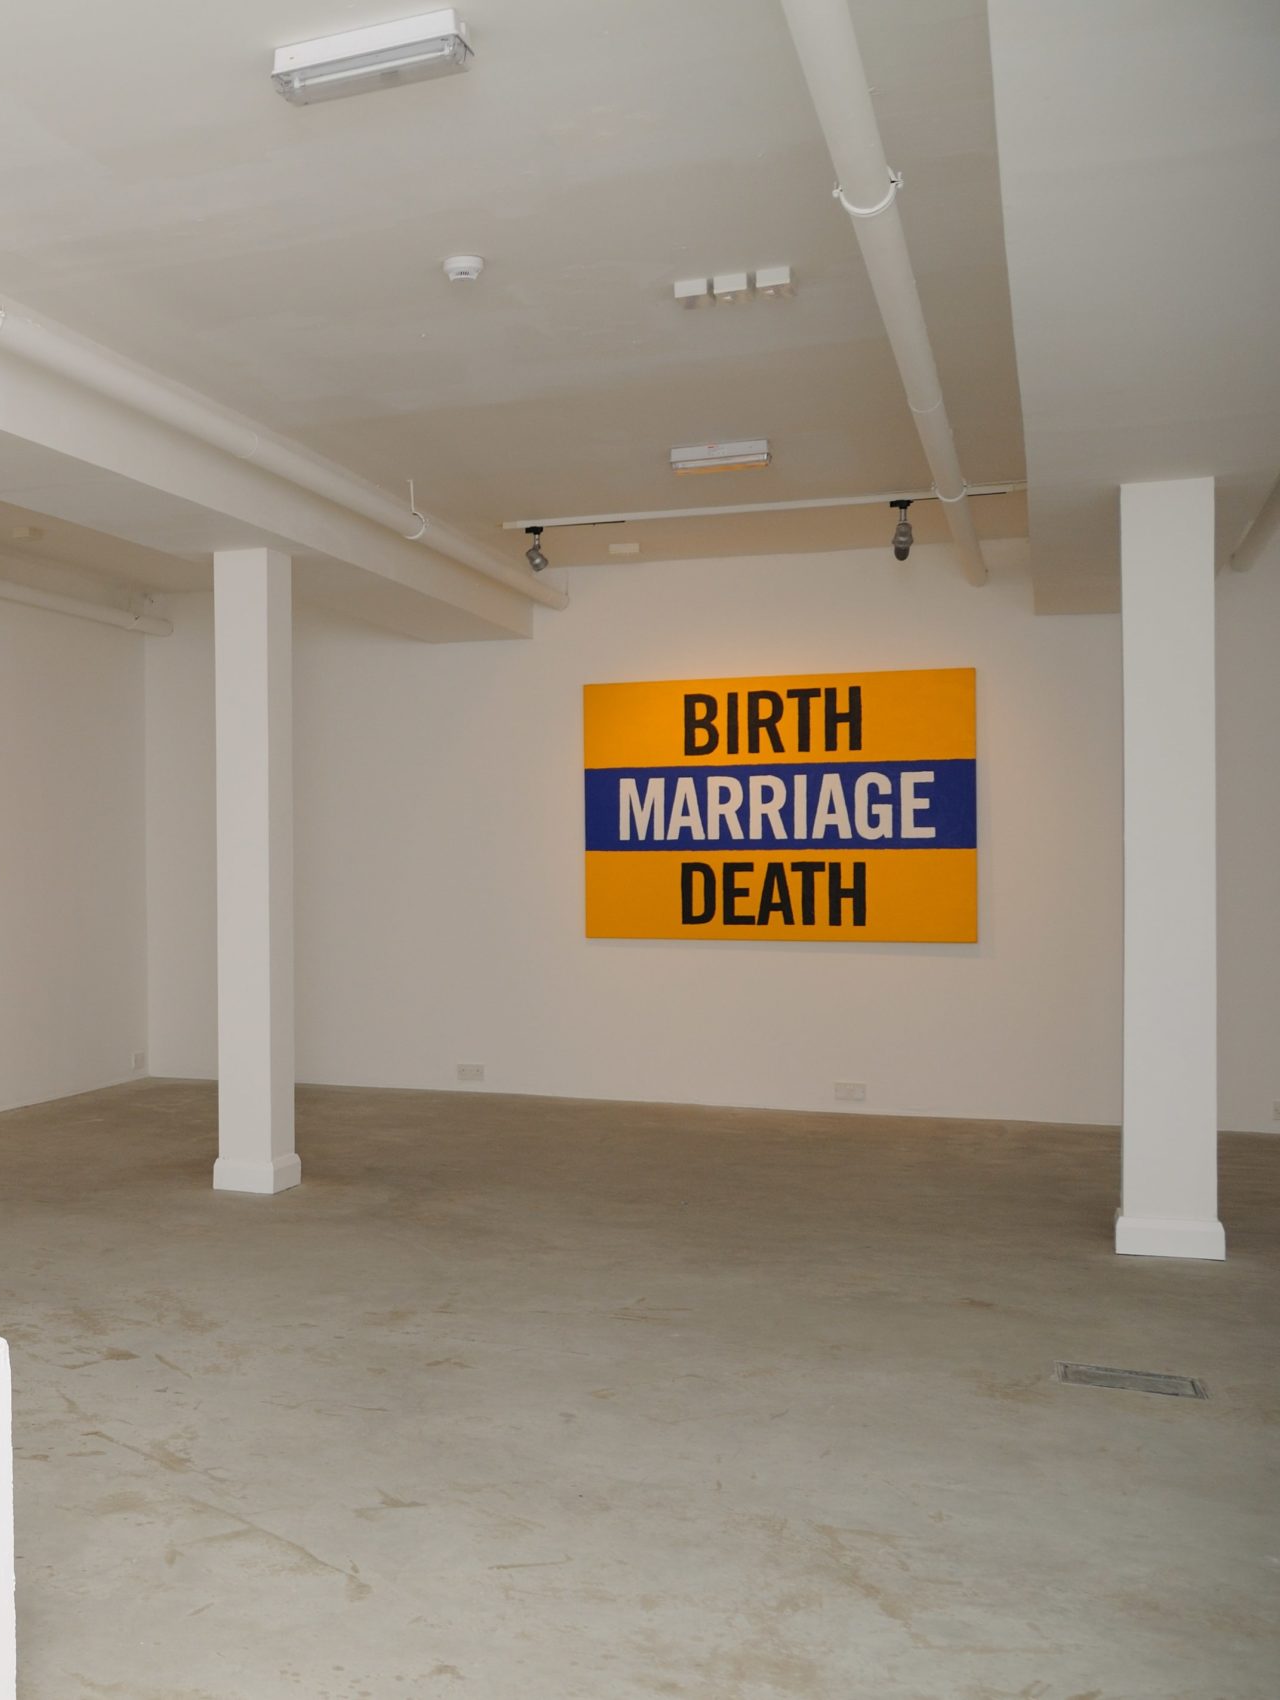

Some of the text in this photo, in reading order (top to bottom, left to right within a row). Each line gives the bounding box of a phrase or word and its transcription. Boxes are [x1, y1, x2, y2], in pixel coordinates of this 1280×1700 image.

[684, 686, 862, 756] BIRTH
[619, 771, 936, 841] MARRIAGE
[681, 862, 866, 926] DEATH
